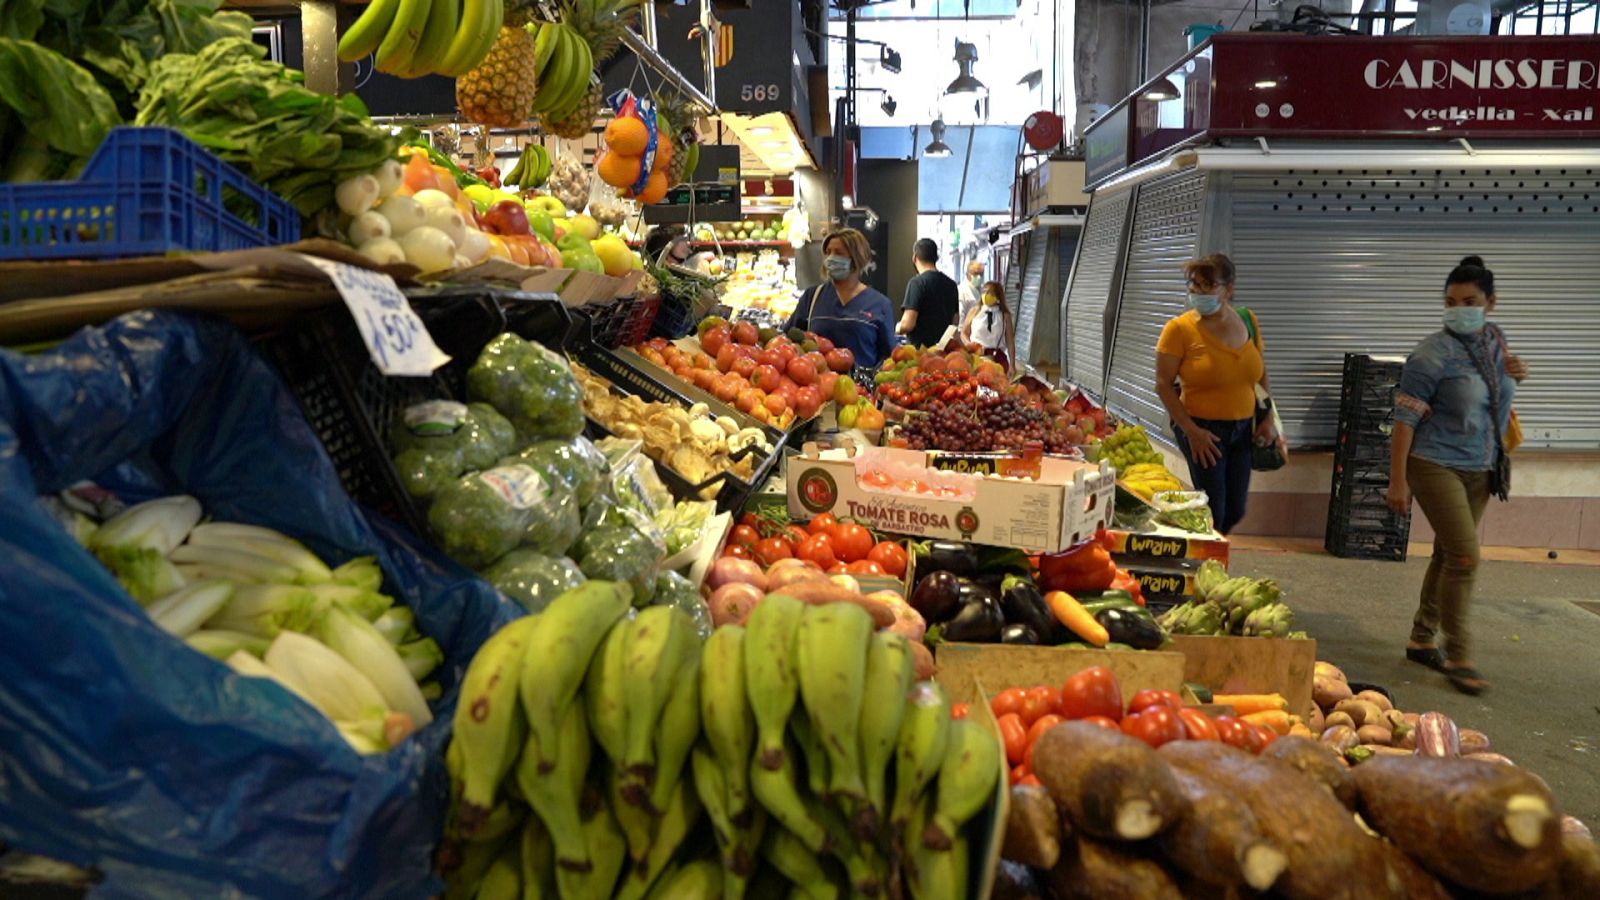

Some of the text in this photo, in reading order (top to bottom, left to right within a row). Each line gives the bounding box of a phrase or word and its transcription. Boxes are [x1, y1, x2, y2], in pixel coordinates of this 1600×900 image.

[741, 84, 780, 101] 569
[1403, 106, 1516, 122] vedella
[1541, 106, 1593, 121] xai
[846, 500, 950, 529] TOMATE ROSA
